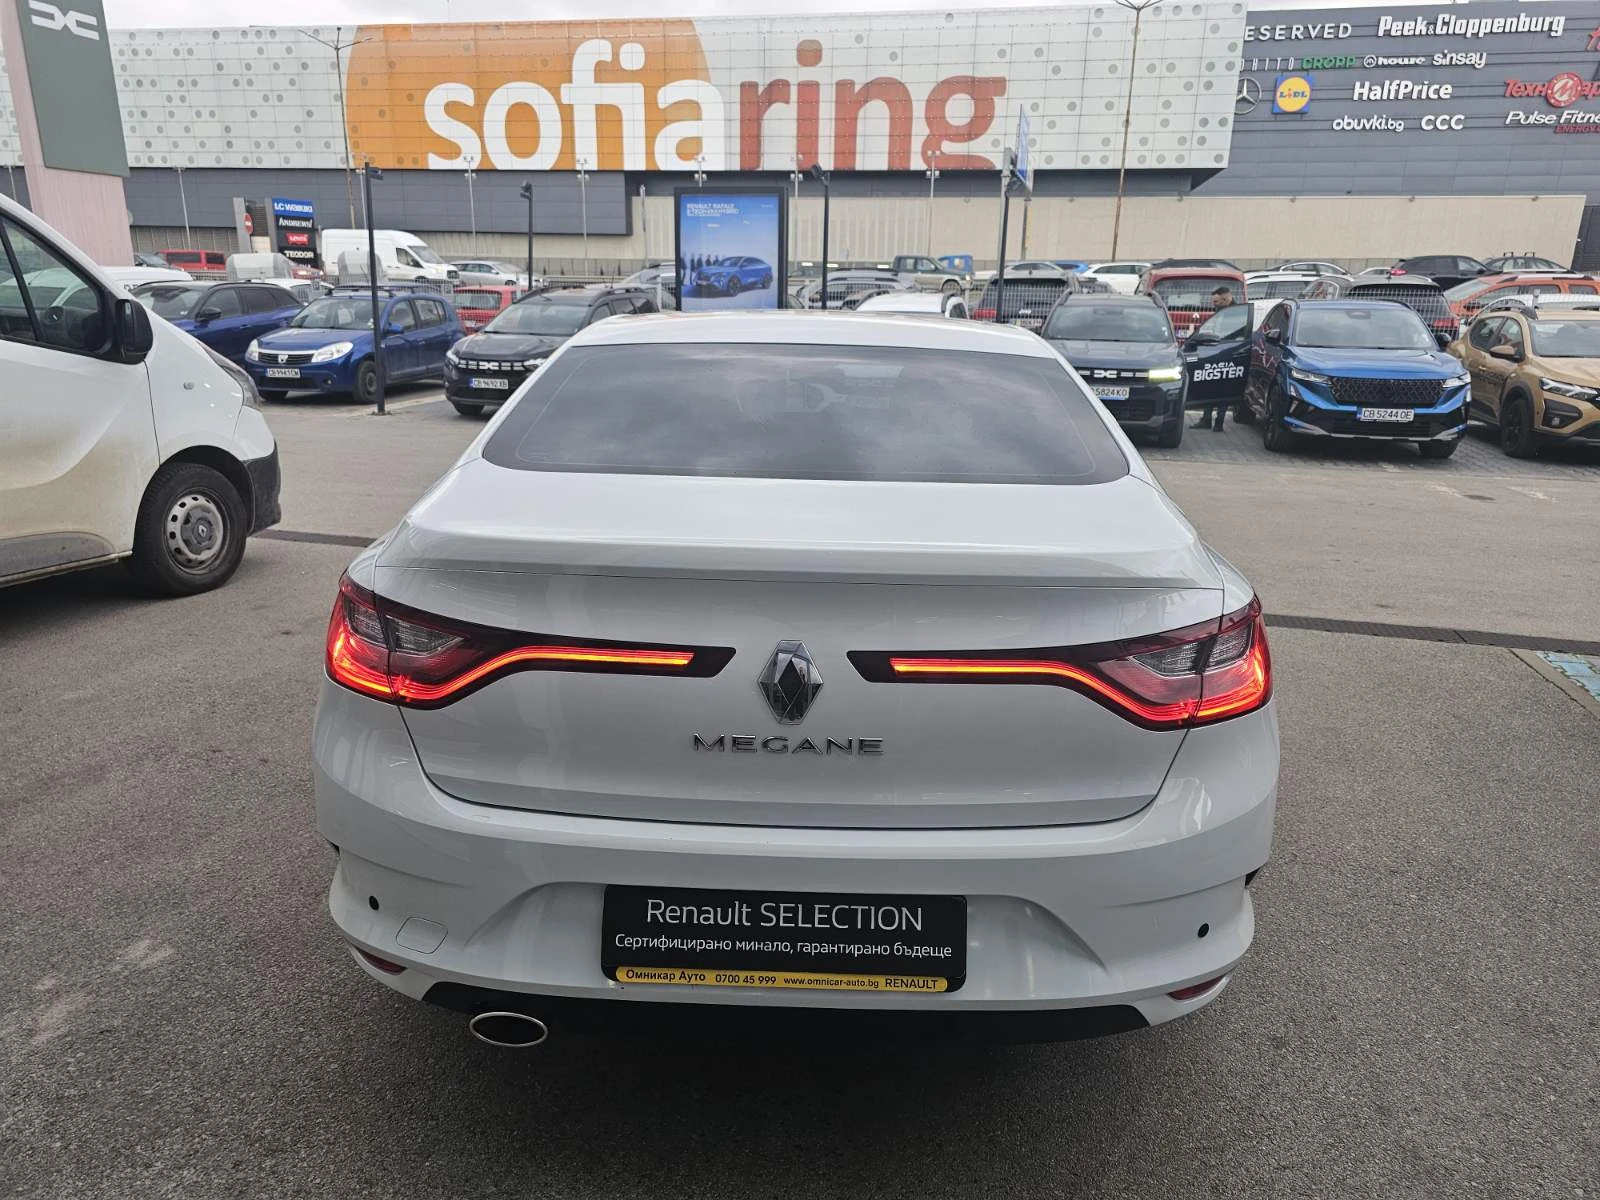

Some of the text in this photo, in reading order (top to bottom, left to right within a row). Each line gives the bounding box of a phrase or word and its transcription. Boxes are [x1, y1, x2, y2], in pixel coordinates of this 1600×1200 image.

[1244, 23, 1352, 41] ESERVED
[1377, 12, 1566, 38] Peek&Cloppenburg
[1302, 55, 1356, 70] CROPP
[1432, 49, 1487, 69] sinsay
[1353, 80, 1453, 101] HalfPrice
[1332, 115, 1405, 132] obuvki.bg
[1421, 115, 1465, 131] CCC
[1505, 110, 1557, 125] Pulse
[1193, 366, 1244, 382] BIGSTER
[693, 732, 885, 756] MEGANE
[646, 899, 922, 931] Renault SELECTION
[615, 933, 952, 959] Сертифицирано минало, гарантирано бъдеще
[625, 969, 706, 983] Омникар Ауто
[715, 974, 777, 985] 0700 45 999
[783, 976, 938, 990] www.omnicar-auto.bg RENAULT
